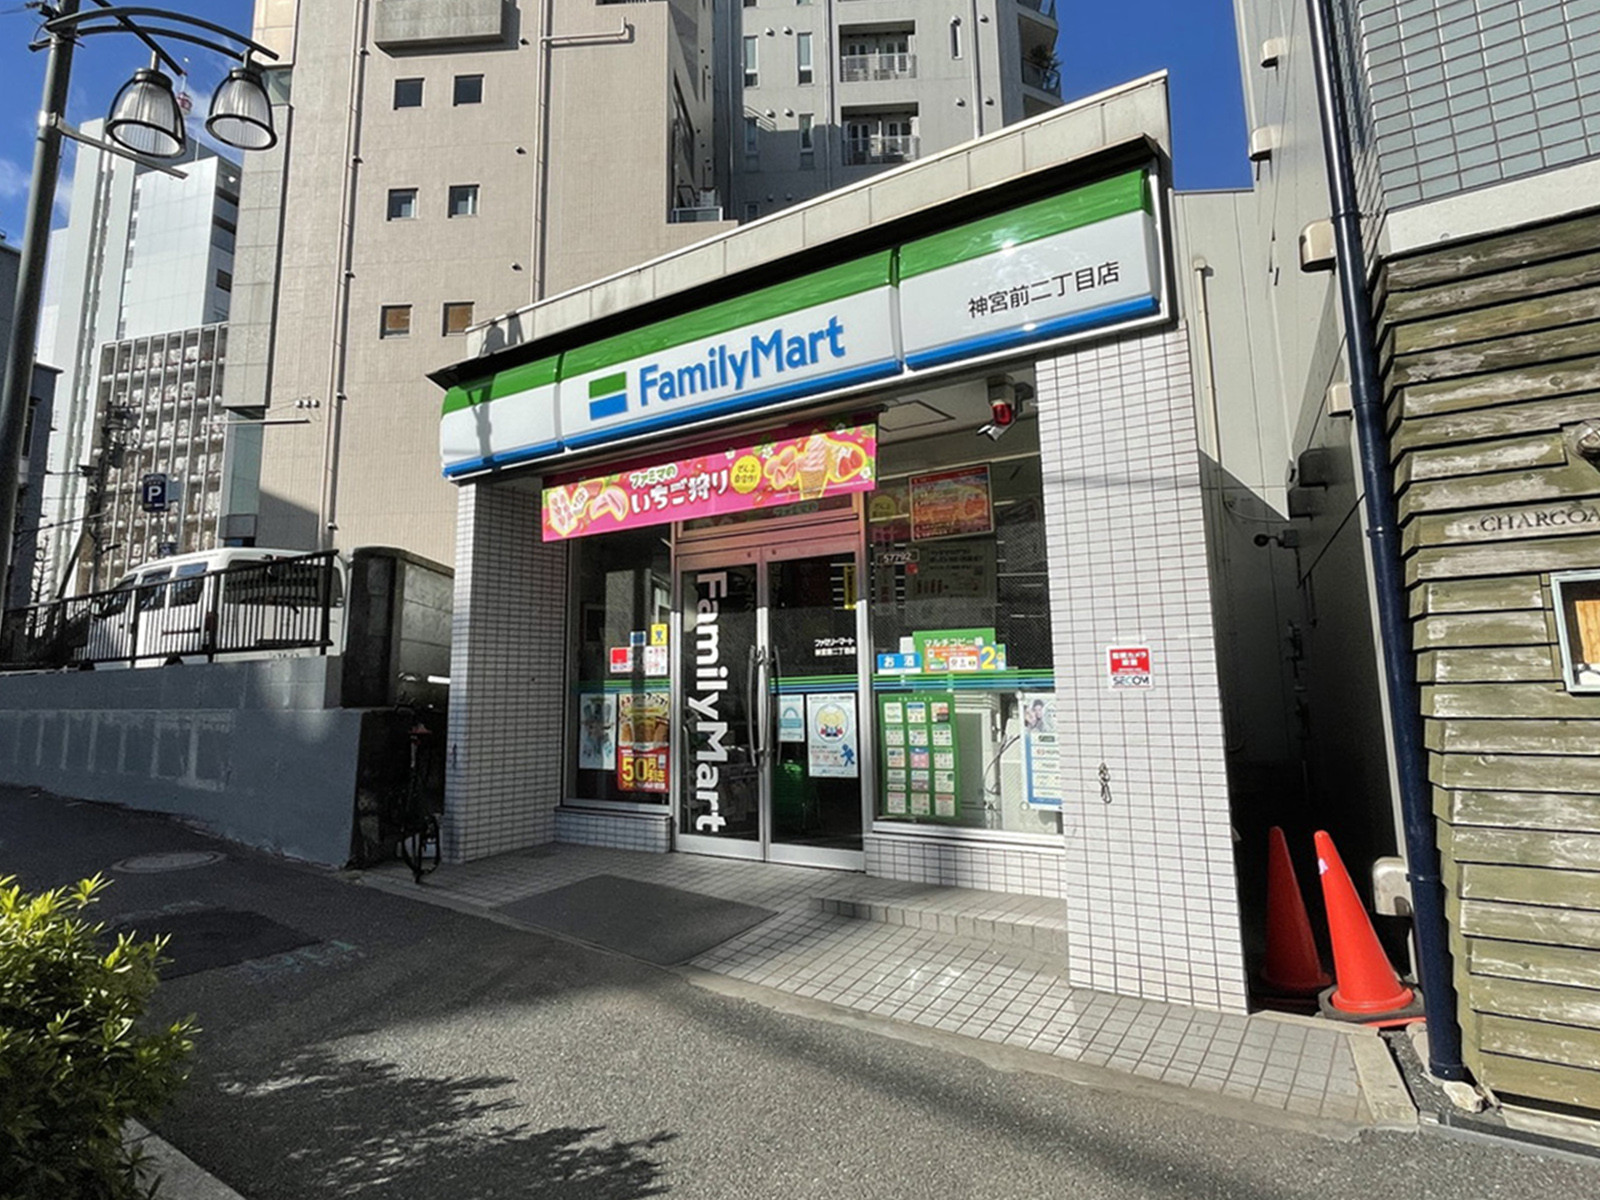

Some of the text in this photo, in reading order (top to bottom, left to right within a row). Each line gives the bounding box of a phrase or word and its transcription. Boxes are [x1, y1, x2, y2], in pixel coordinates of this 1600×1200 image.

[968, 261, 1120, 319] 神宮前二丁目店
[640, 315, 846, 406] FamilyMart
[148, 485, 162, 502] P
[630, 464, 677, 488] ファミマの
[631, 469, 728, 513] いちご狩り
[688, 571, 729, 833] FamilyMart
[1113, 675, 1150, 686] SECOM
